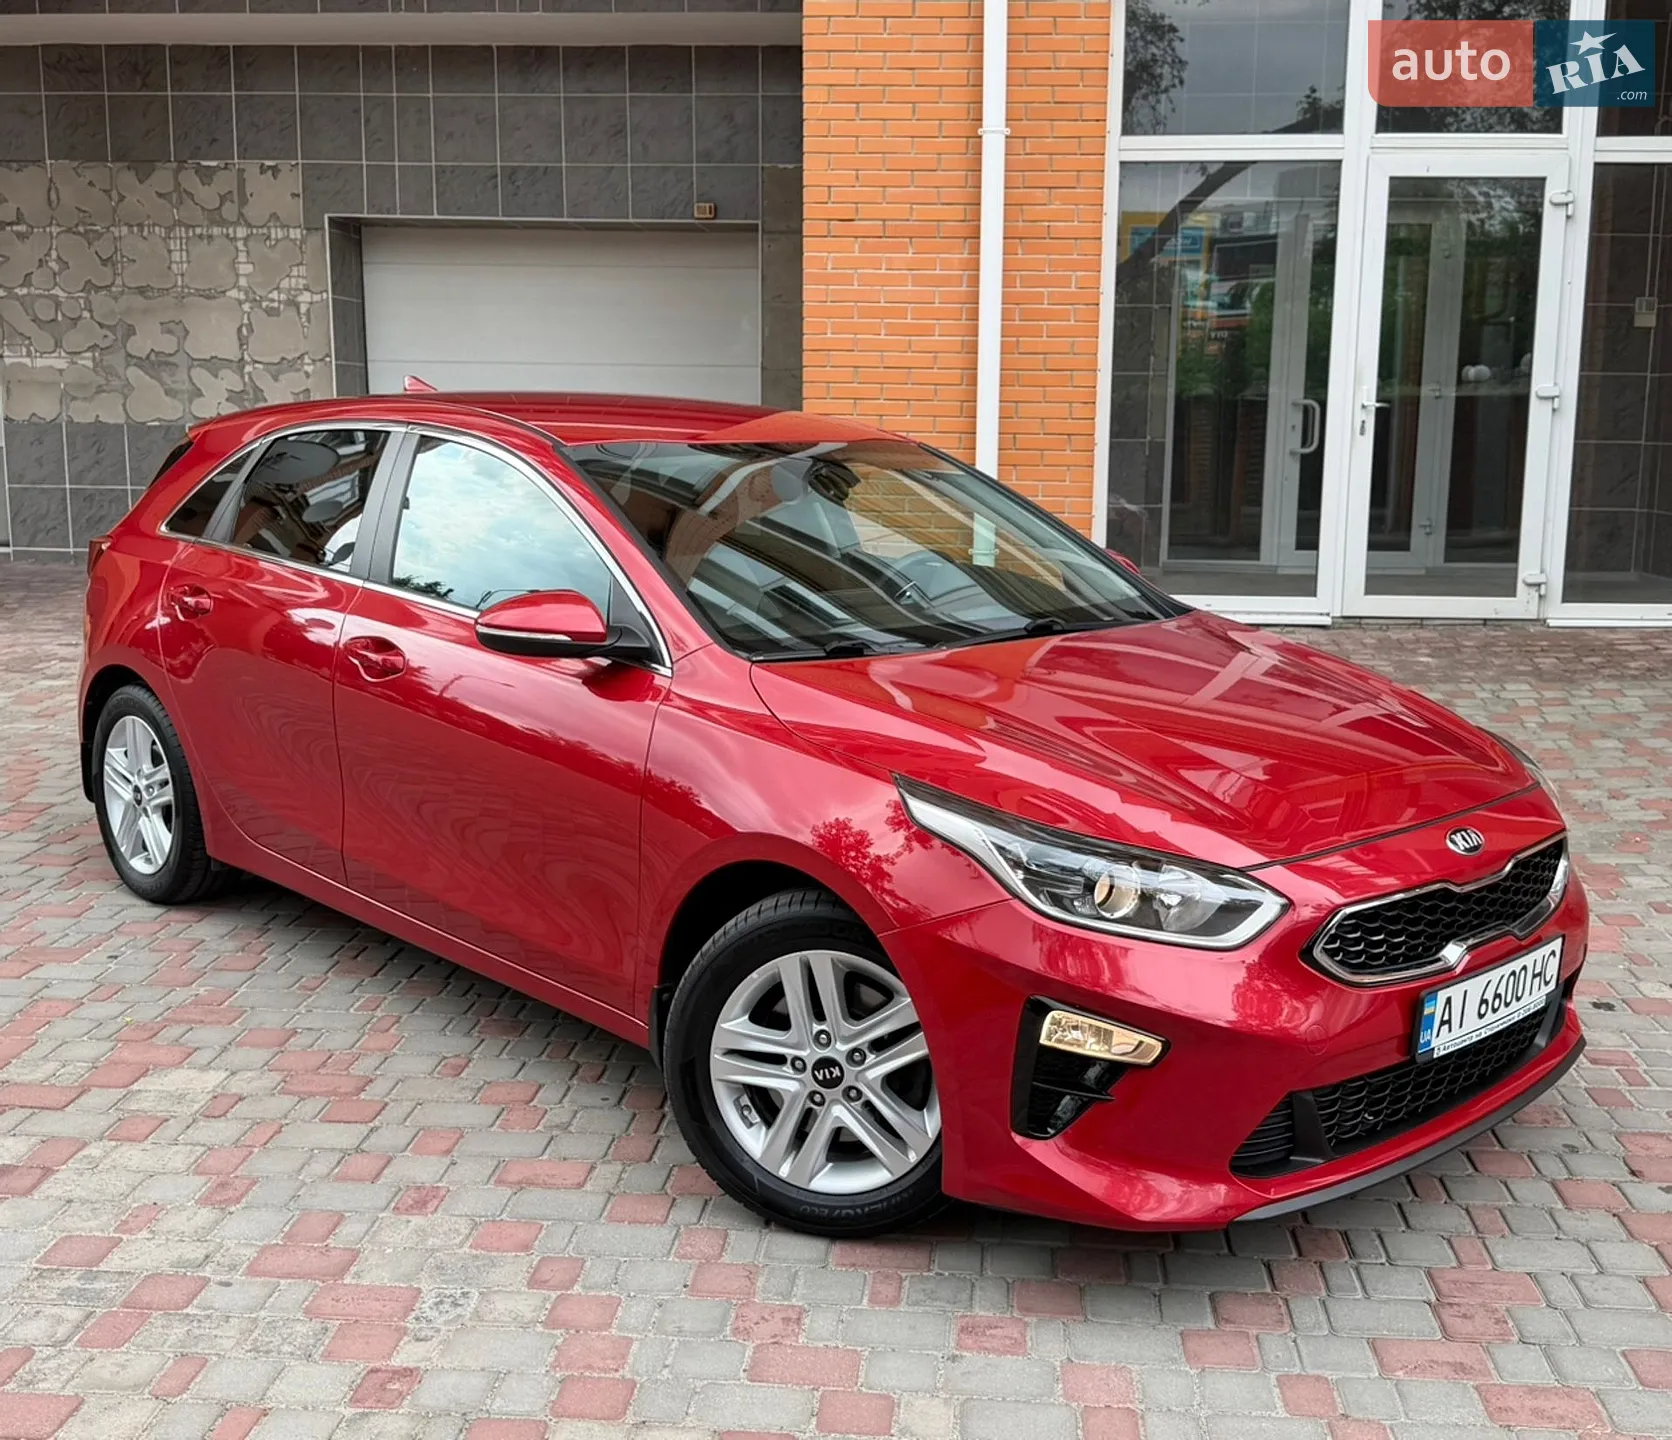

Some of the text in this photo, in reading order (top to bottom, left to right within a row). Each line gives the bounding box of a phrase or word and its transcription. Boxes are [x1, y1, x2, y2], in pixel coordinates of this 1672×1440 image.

[1451, 830, 1482, 850] KIA
[1435, 949, 1556, 1039] AI 6600 HC
[1420, 1029, 1432, 1043] UA
[814, 1066, 841, 1080] KIA
